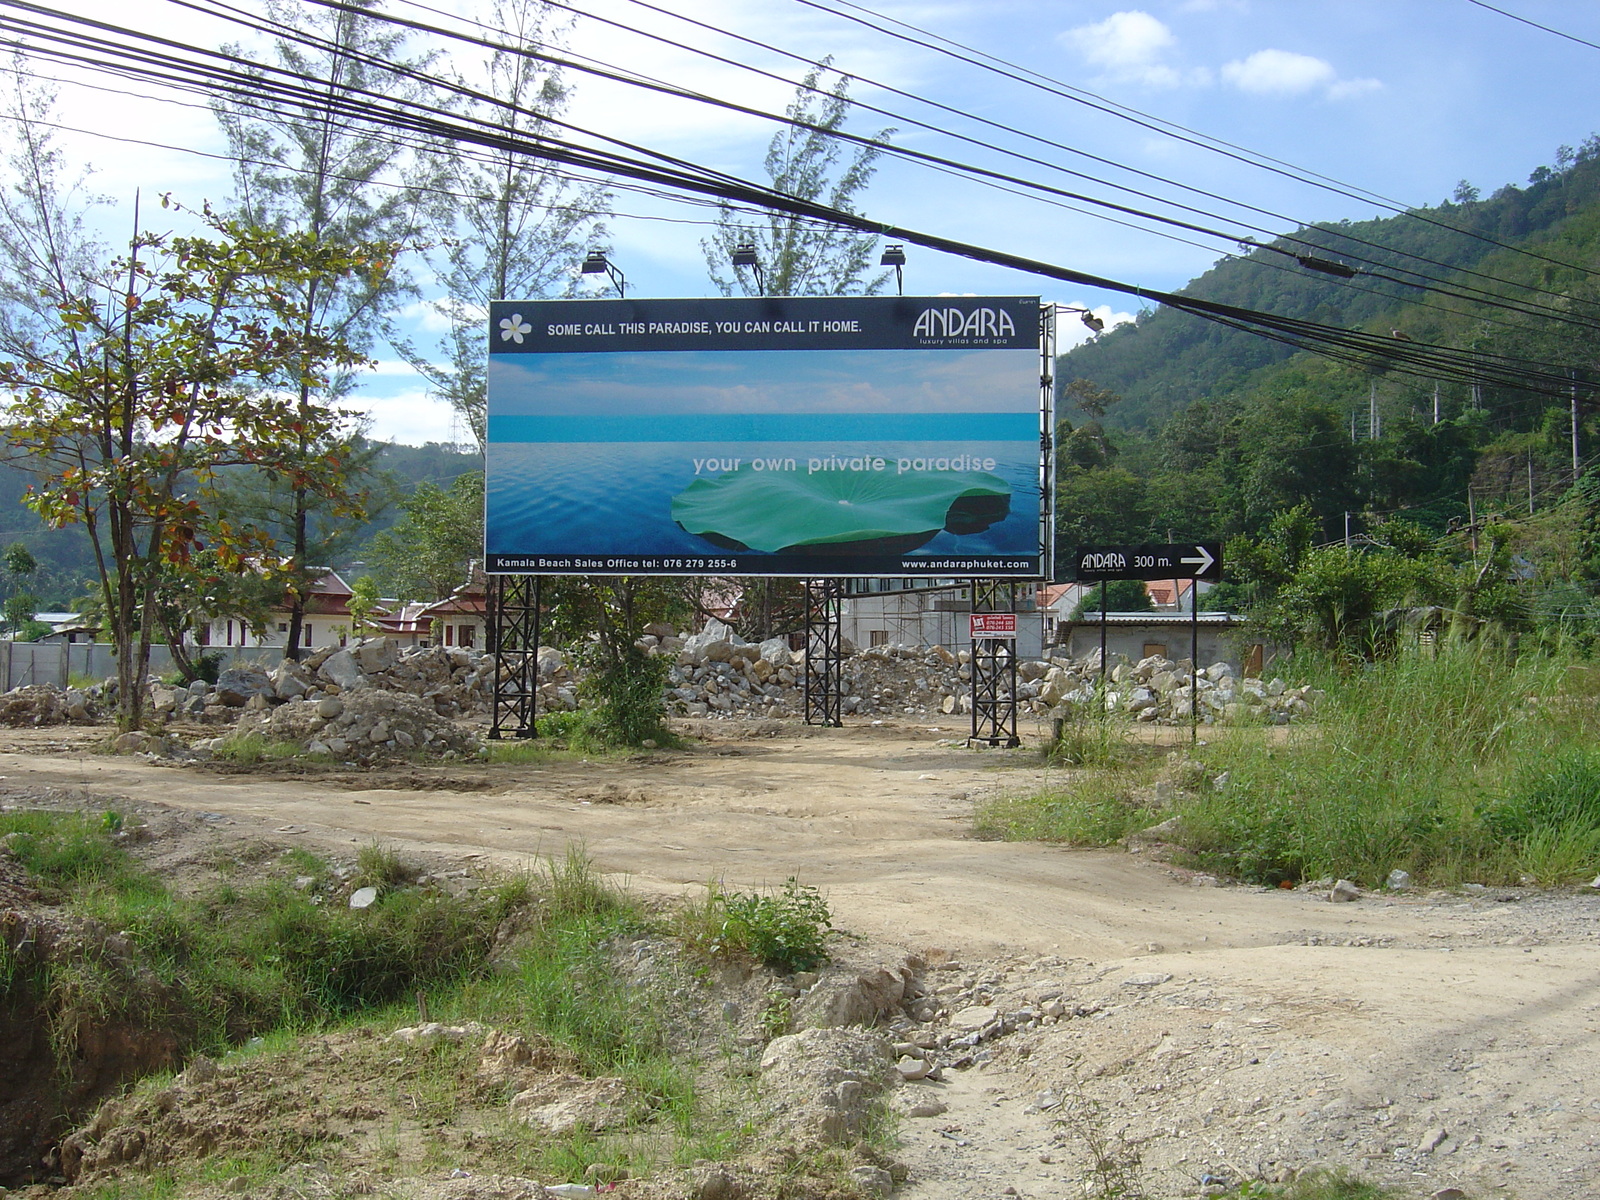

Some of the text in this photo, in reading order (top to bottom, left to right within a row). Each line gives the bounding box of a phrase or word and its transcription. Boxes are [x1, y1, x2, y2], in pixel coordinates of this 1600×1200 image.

[548, 321, 862, 336] SOME CALL THIS PARADISE, YOU CAN CALL IT HOME.
[913, 308, 1016, 337] ANDARA
[692, 454, 996, 475] your own private paradise
[497, 558, 737, 568] Kamala Beach Sales Office tel: 076 279 255-6
[901, 560, 1029, 570] www.andaraphuket.com
[1081, 553, 1172, 568] ANDARA 300 m.
